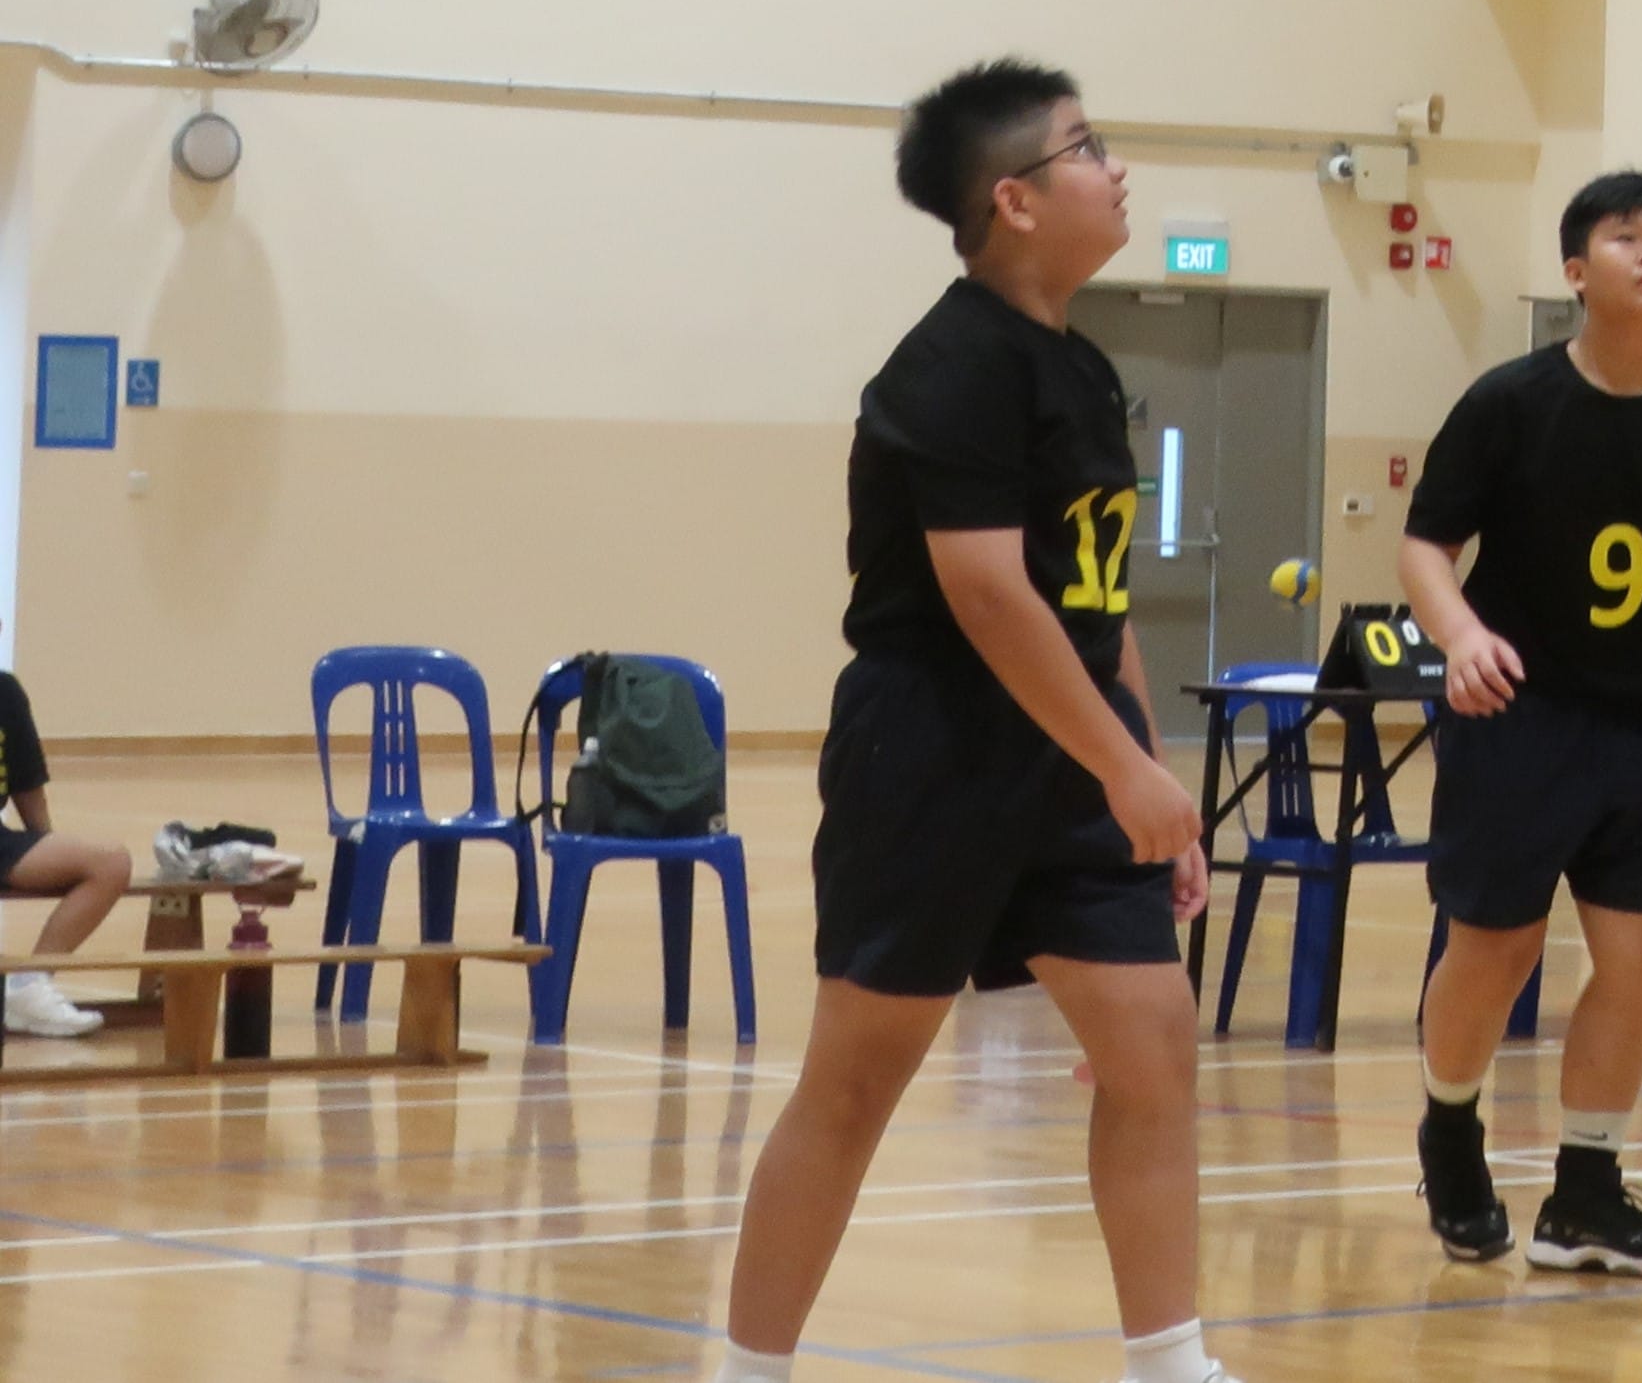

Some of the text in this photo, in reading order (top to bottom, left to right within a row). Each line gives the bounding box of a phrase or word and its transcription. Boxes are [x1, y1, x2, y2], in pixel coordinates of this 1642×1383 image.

[1177, 242, 1216, 270] EXIT
[1062, 487, 1137, 615] 12
[1365, 620, 1421, 667] 0 0
